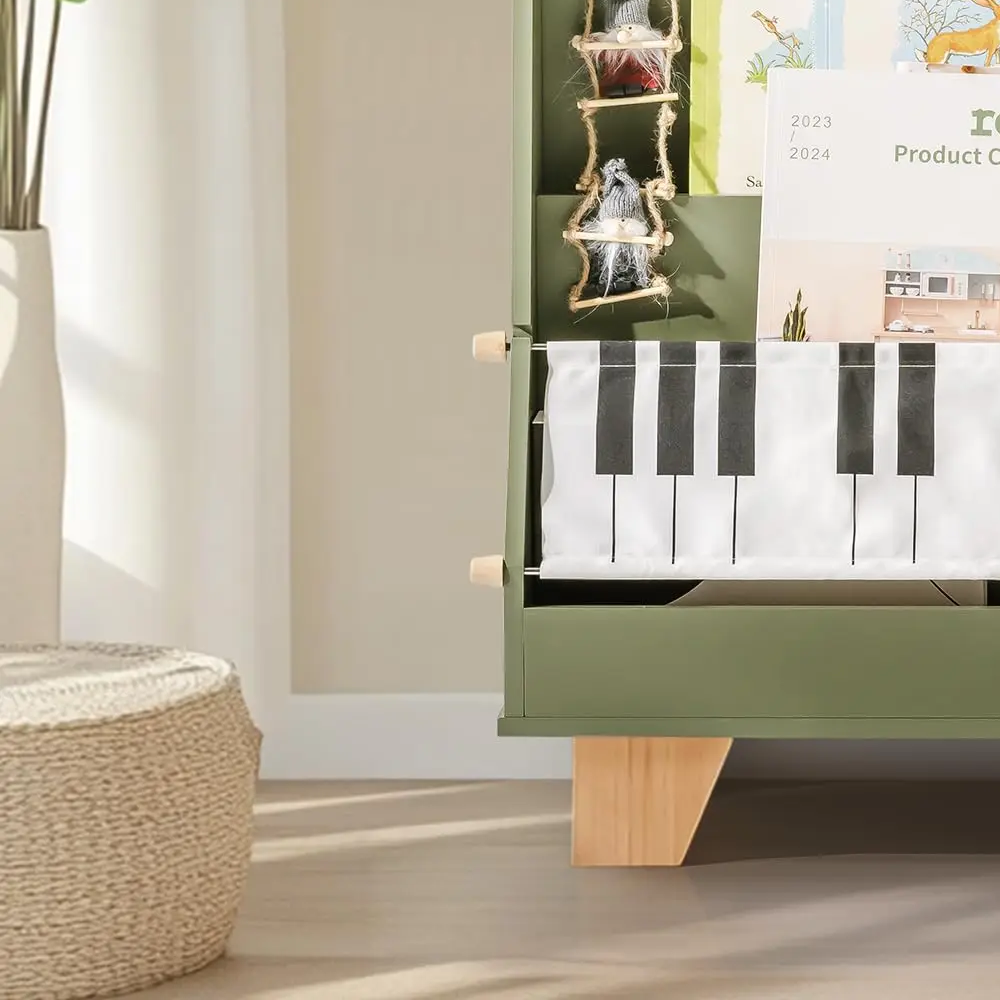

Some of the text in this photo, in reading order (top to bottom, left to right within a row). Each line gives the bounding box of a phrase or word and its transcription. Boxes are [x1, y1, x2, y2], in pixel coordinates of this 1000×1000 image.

[791, 115, 832, 128] 2023
[789, 147, 831, 161] 2024
[894, 144, 982, 165] Product
[746, 175, 763, 188] Sa
